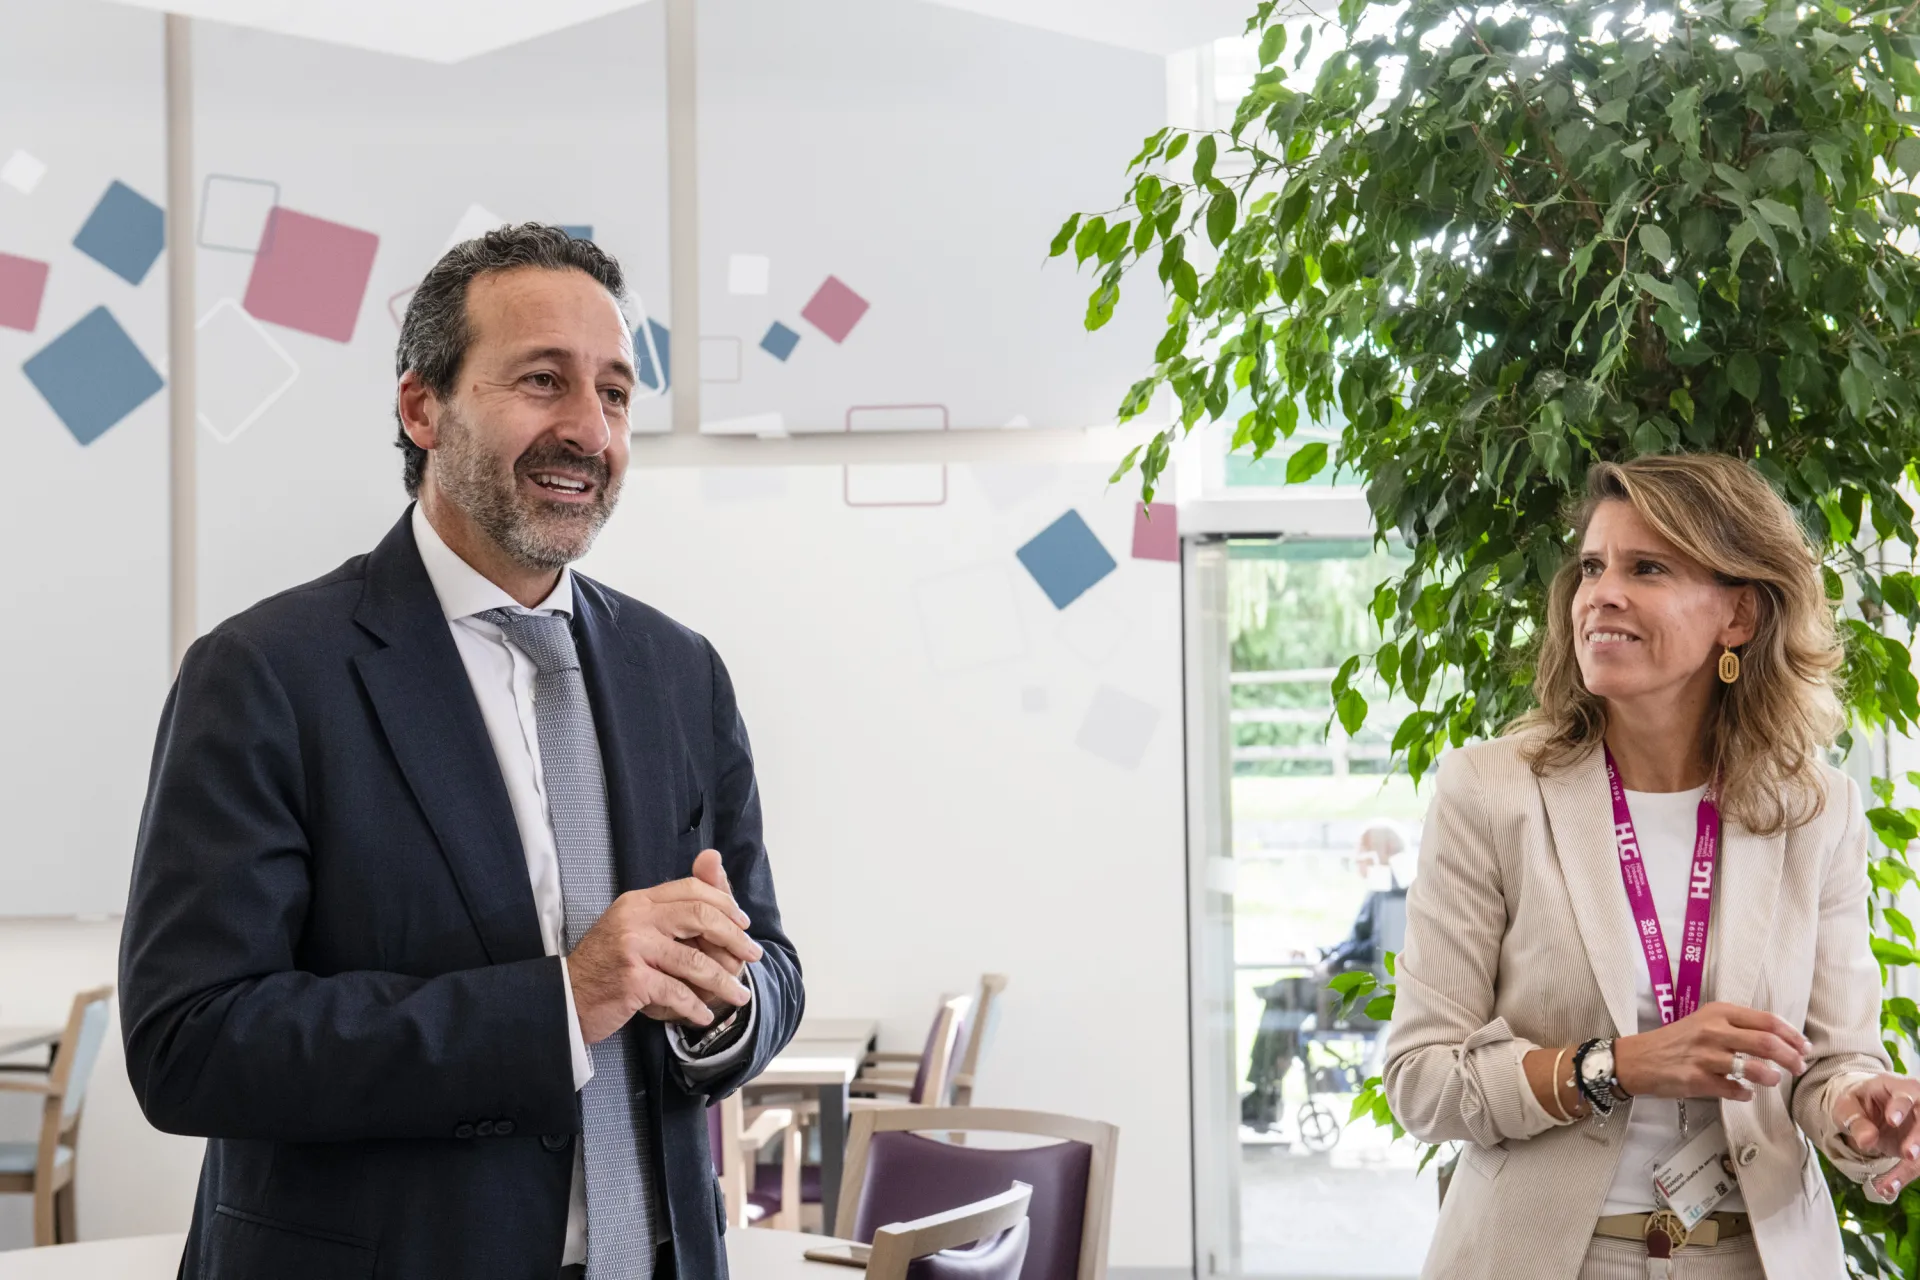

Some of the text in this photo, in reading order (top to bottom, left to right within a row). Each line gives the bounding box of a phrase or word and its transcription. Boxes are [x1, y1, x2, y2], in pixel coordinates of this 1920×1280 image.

[1612, 781, 1621, 801] 1995
[1616, 822, 1640, 861] HUG
[1690, 861, 1712, 899] HUG
[1640, 920, 1656, 961] ANS 2025
[1646, 919, 1664, 960] 30 1995
[1685, 920, 1696, 962] 30 1995
[1694, 921, 1704, 963] ANS 2025
[1655, 983, 1674, 1024] HUG
